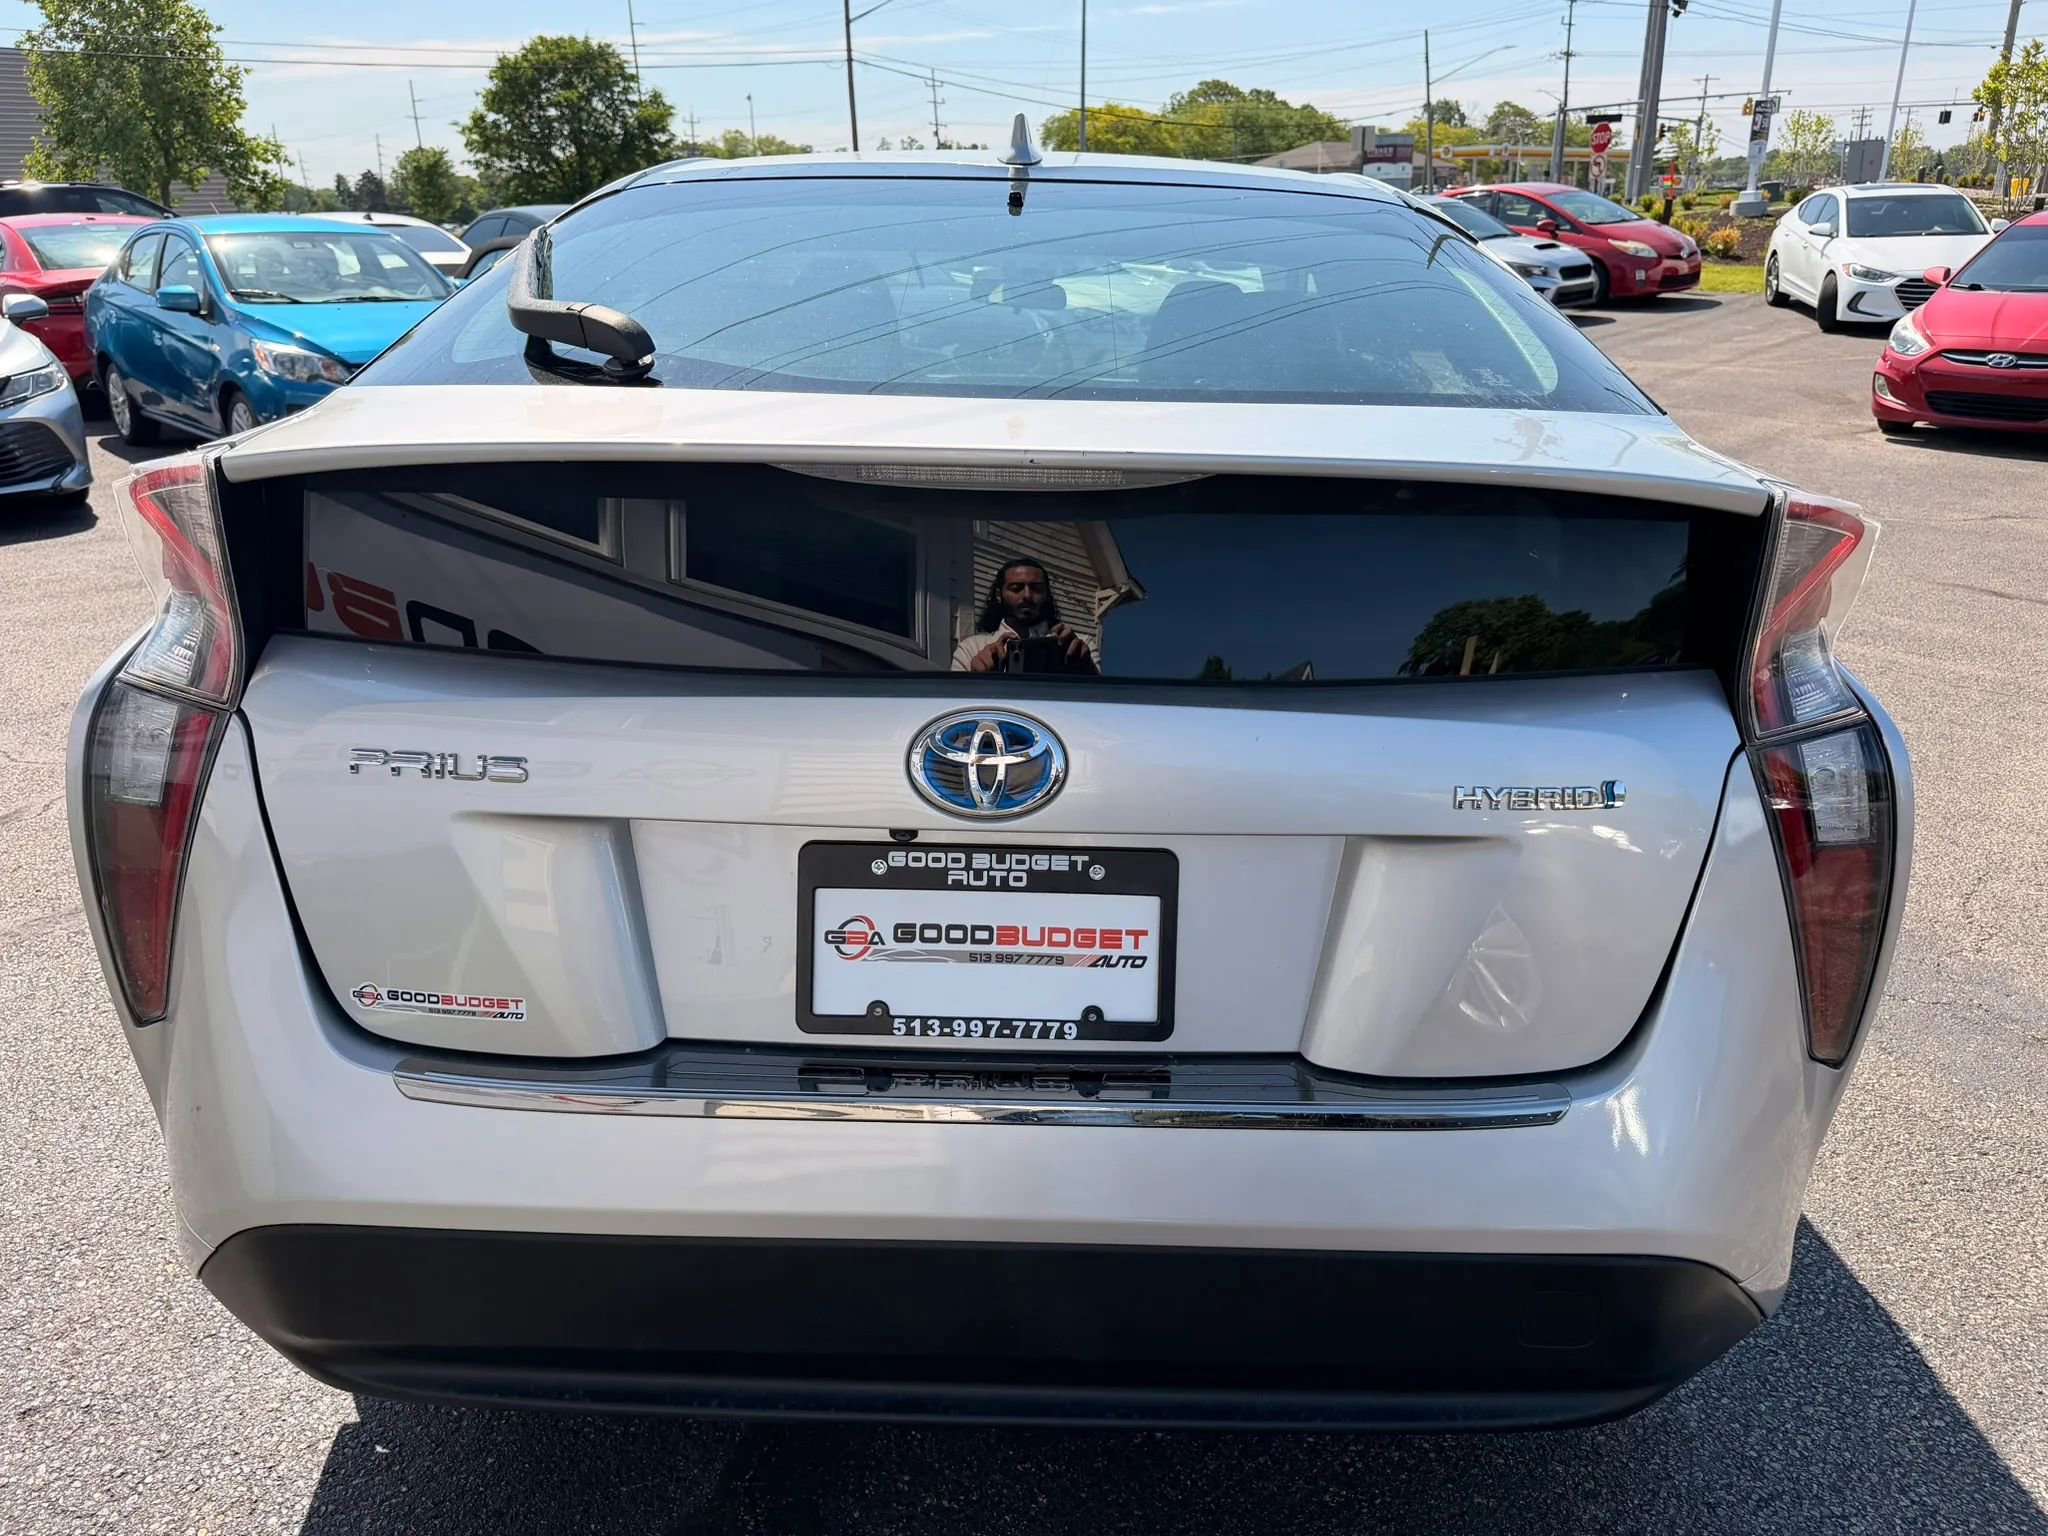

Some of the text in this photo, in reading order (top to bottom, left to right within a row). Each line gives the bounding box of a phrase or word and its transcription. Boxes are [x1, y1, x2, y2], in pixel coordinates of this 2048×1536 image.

[1591, 132, 1610, 145] STOP
[349, 748, 529, 783] PRIUS
[1453, 785, 1602, 810] HYBRID
[887, 851, 1090, 871] GOOD BUDGET
[947, 870, 1028, 887] AUTO
[823, 929, 886, 946] GBA
[968, 952, 1064, 965] 513 997 7779
[1090, 955, 1148, 969] AUTO
[492, 1011, 524, 1020] AUTO
[892, 1018, 1078, 1040] 513-997-7779
